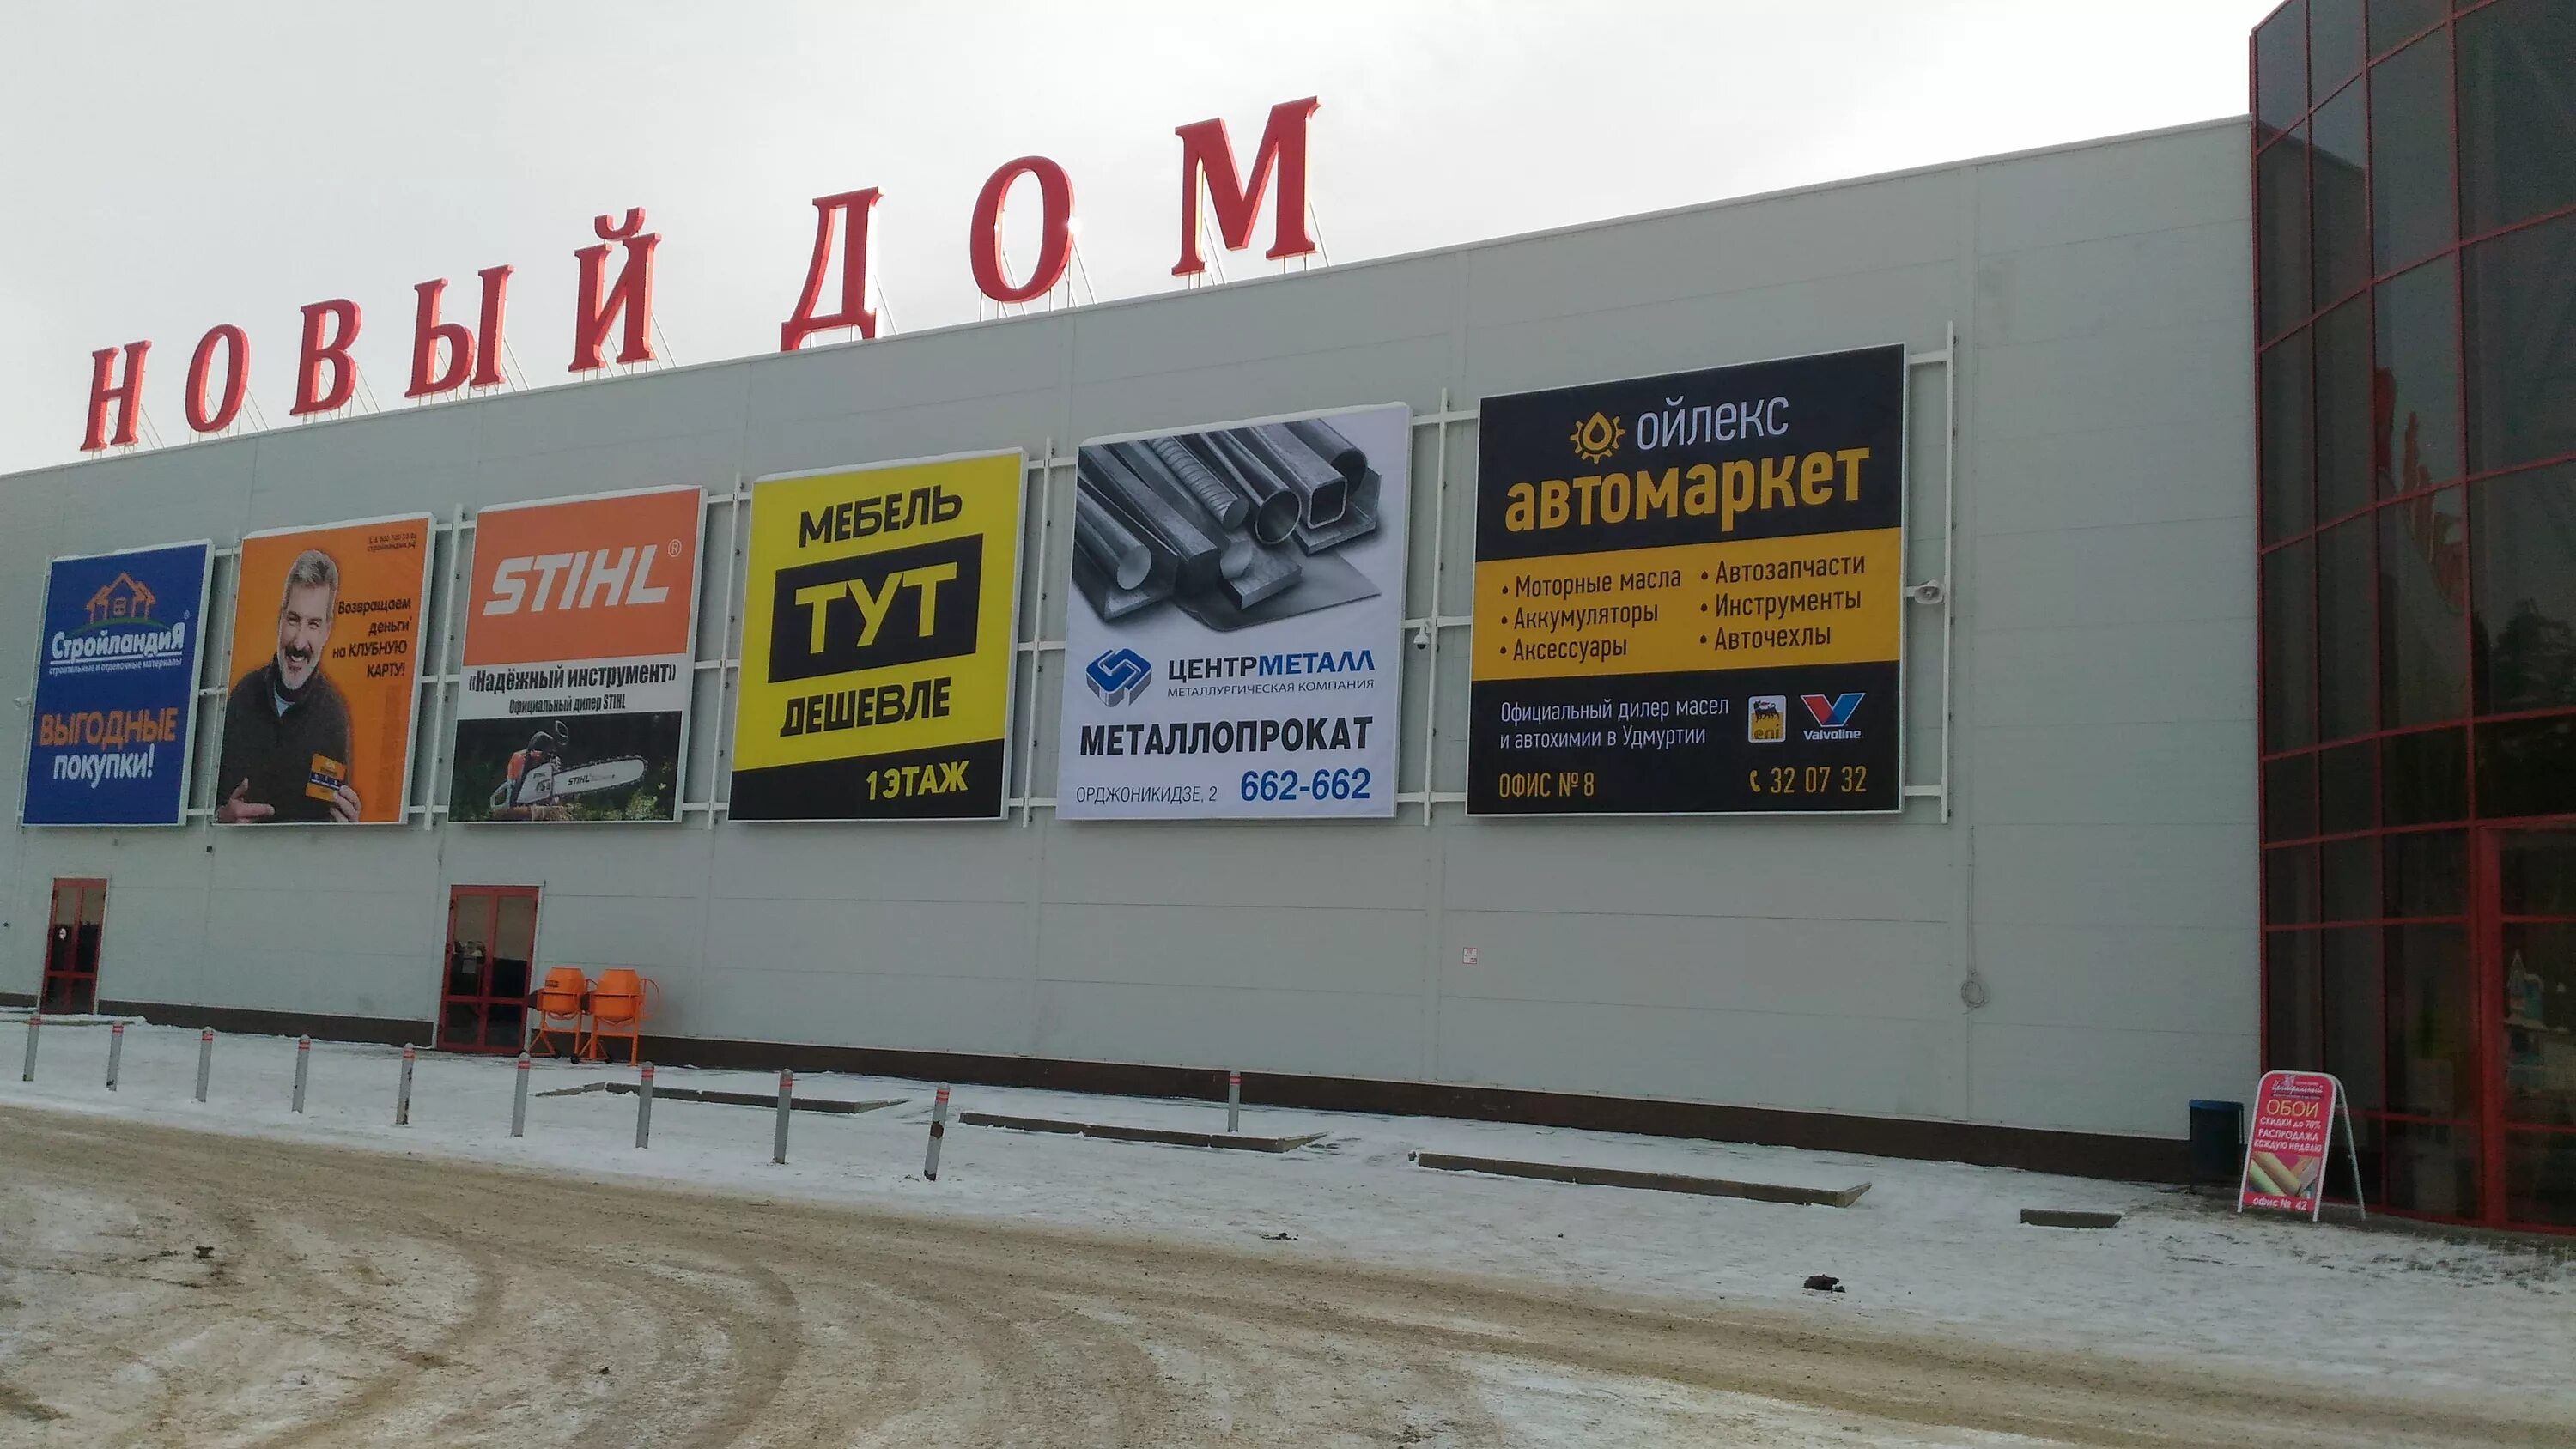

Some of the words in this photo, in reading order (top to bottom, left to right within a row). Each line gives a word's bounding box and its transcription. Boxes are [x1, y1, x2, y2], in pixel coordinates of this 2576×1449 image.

[80, 207, 661, 452] НОВЫЙ
[781, 95, 1320, 353] ДОМ
[1504, 447, 1870, 533] автомаркет
[798, 484, 963, 549] МЕБЕЛЬ
[482, 544, 670, 616] STIHL
[1516, 574, 1613, 599] Моторные
[1619, 567, 1682, 591] масла
[1716, 555, 1866, 585] Автозапчасти
[337, 598, 411, 616] Возвращаем
[795, 561, 958, 655] ТУТ
[1513, 601, 1659, 633] Аккумуляторы
[1716, 590, 1862, 621] Инструменты
[332, 647, 346, 658] на
[349, 640, 408, 658] КЛУБНУЮ
[1513, 636, 1628, 664] Аксессуары
[1714, 627, 1832, 652] Авточехлы
[367, 662, 405, 677] КАРТУ!
[469, 664, 564, 694] «Надёжный
[567, 663, 677, 688] инструмент»
[1167, 682, 1295, 698] МЕТАЛЛУРГИЧЕСКАЯ
[1298, 679, 1375, 692] КОМПАНИЯ
[508, 695, 571, 715] Официальный
[573, 697, 602, 712] дилер
[603, 694, 626, 709] STIHL
[780, 676, 951, 737] ДЕШЕВЛЕ
[1501, 698, 1613, 727] Официальный
[1618, 700, 1669, 722] дилер
[1675, 698, 1729, 716] масел
[39, 706, 179, 752] ВЫГОДНЫЕ
[1079, 716, 1374, 756] МЕТАЛЛОПРОКАТ
[1500, 734, 1510, 749] и
[1515, 730, 1601, 749] автохимии
[1607, 731, 1617, 747] в
[1623, 724, 1706, 750] Удмуртии
[1753, 724, 1781, 739] eni
[1803, 729, 1862, 740] Valvoline
[53, 743, 155, 789] покупки!
[568, 775, 590, 785] STIHL
[1771, 767, 1795, 793] 32
[1805, 767, 1831, 793] 07
[1841, 765, 1867, 792] 32
[1076, 785, 1205, 804] ОРДЖОНИКИДЗЕ,
[1208, 786, 1218, 802] 2
[1240, 767, 1372, 802] 662-662
[1499, 772, 1551, 797] ОФИС
[1558, 772, 1579, 797] №
[1583, 772, 1595, 797] 8
[2259, 1116, 2292, 1127] СКИДКИ
[2267, 1099, 2319, 1119] ОБОИ
[2258, 1128, 2318, 1141] РАСПРОДАЖА
[2252, 1197, 2277, 1208] офис
[2280, 1198, 2292, 1209] №
[2295, 1200, 2308, 1210] 42
